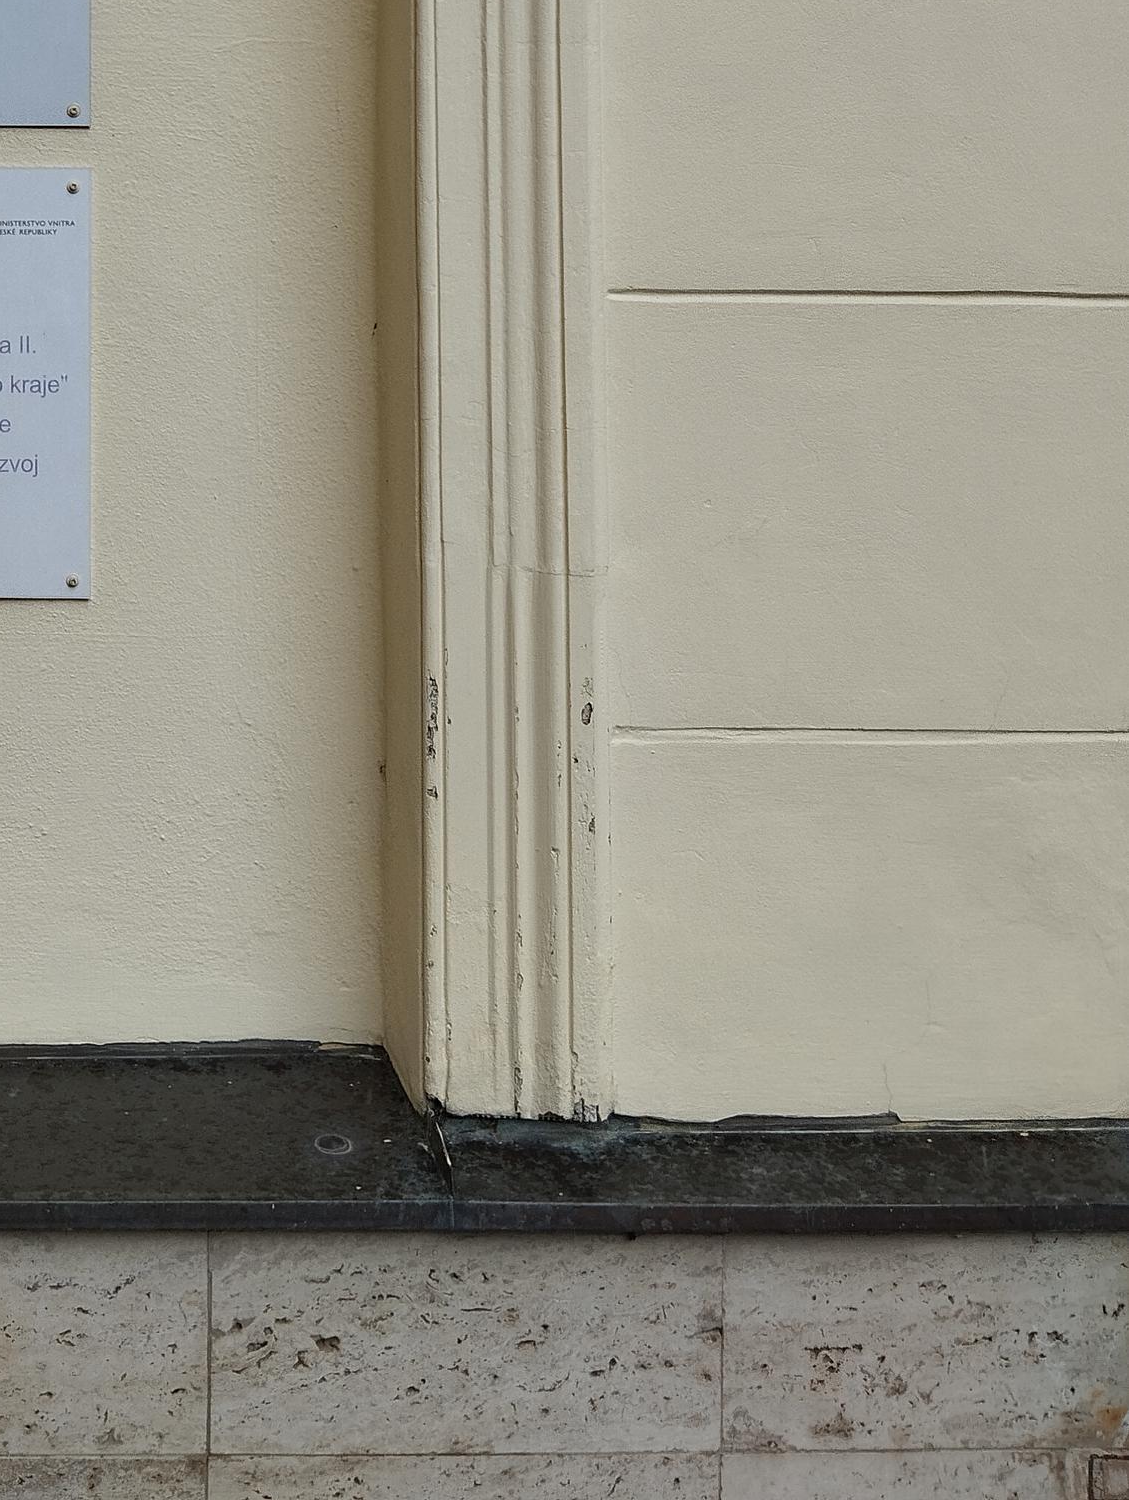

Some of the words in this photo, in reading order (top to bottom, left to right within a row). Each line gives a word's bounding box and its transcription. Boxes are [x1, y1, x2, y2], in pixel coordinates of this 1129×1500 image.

[47, 219, 76, 227] VNITRA
[19, 228, 58, 236] REPUBLIKY
[19, 335, 37, 355] II.
[10, 374, 69, 399] kraje"
